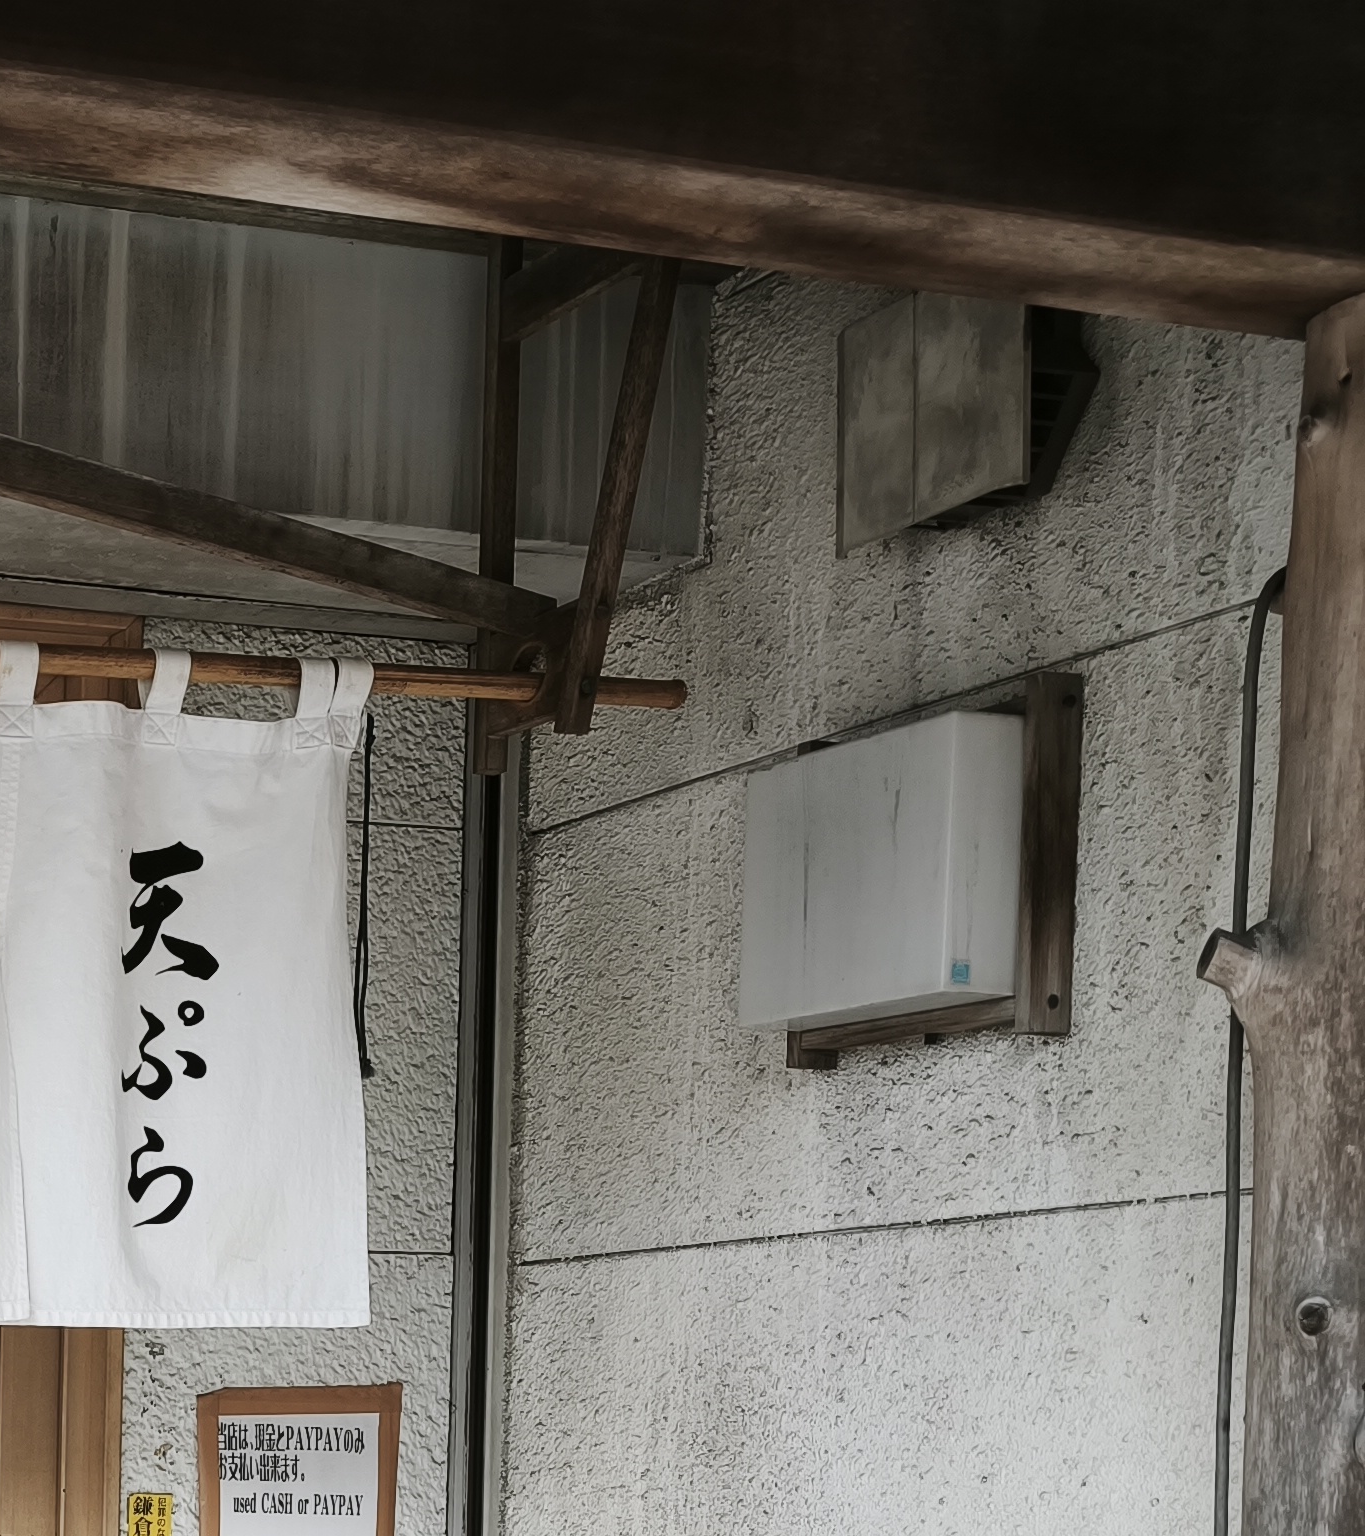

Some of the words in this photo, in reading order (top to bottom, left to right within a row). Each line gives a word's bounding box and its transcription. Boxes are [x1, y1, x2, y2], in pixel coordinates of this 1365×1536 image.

[121, 841, 219, 1227] 天ぷら
[233, 1493, 257, 1514] used
[261, 1493, 293, 1514] CASH
[297, 1498, 310, 1515] or
[313, 1494, 364, 1516] PAYPAY
